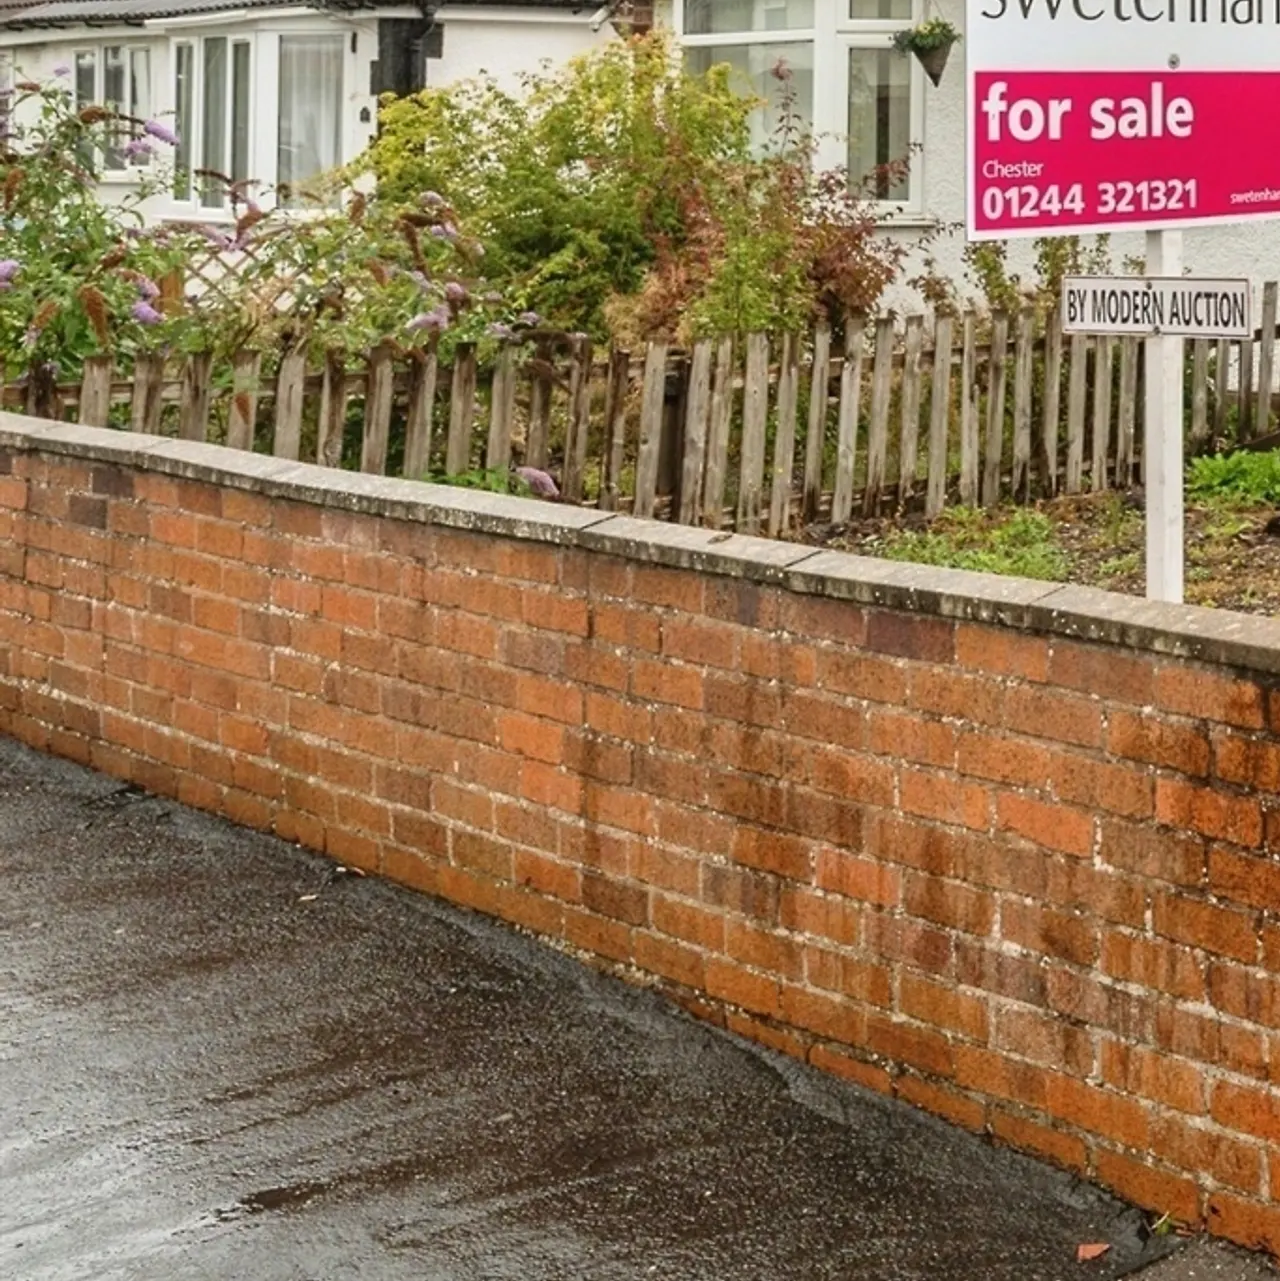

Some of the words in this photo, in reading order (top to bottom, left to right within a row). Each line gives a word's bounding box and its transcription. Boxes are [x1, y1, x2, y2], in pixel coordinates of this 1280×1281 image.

[982, 82, 1072, 141] for
[1090, 82, 1194, 139] sale
[982, 160, 1044, 178] Chester
[982, 184, 1085, 220] 01244
[1098, 179, 1197, 213] 321321
[1067, 289, 1089, 324] BY
[1092, 290, 1165, 326] MODERN
[1169, 291, 1245, 328] AUCTION
